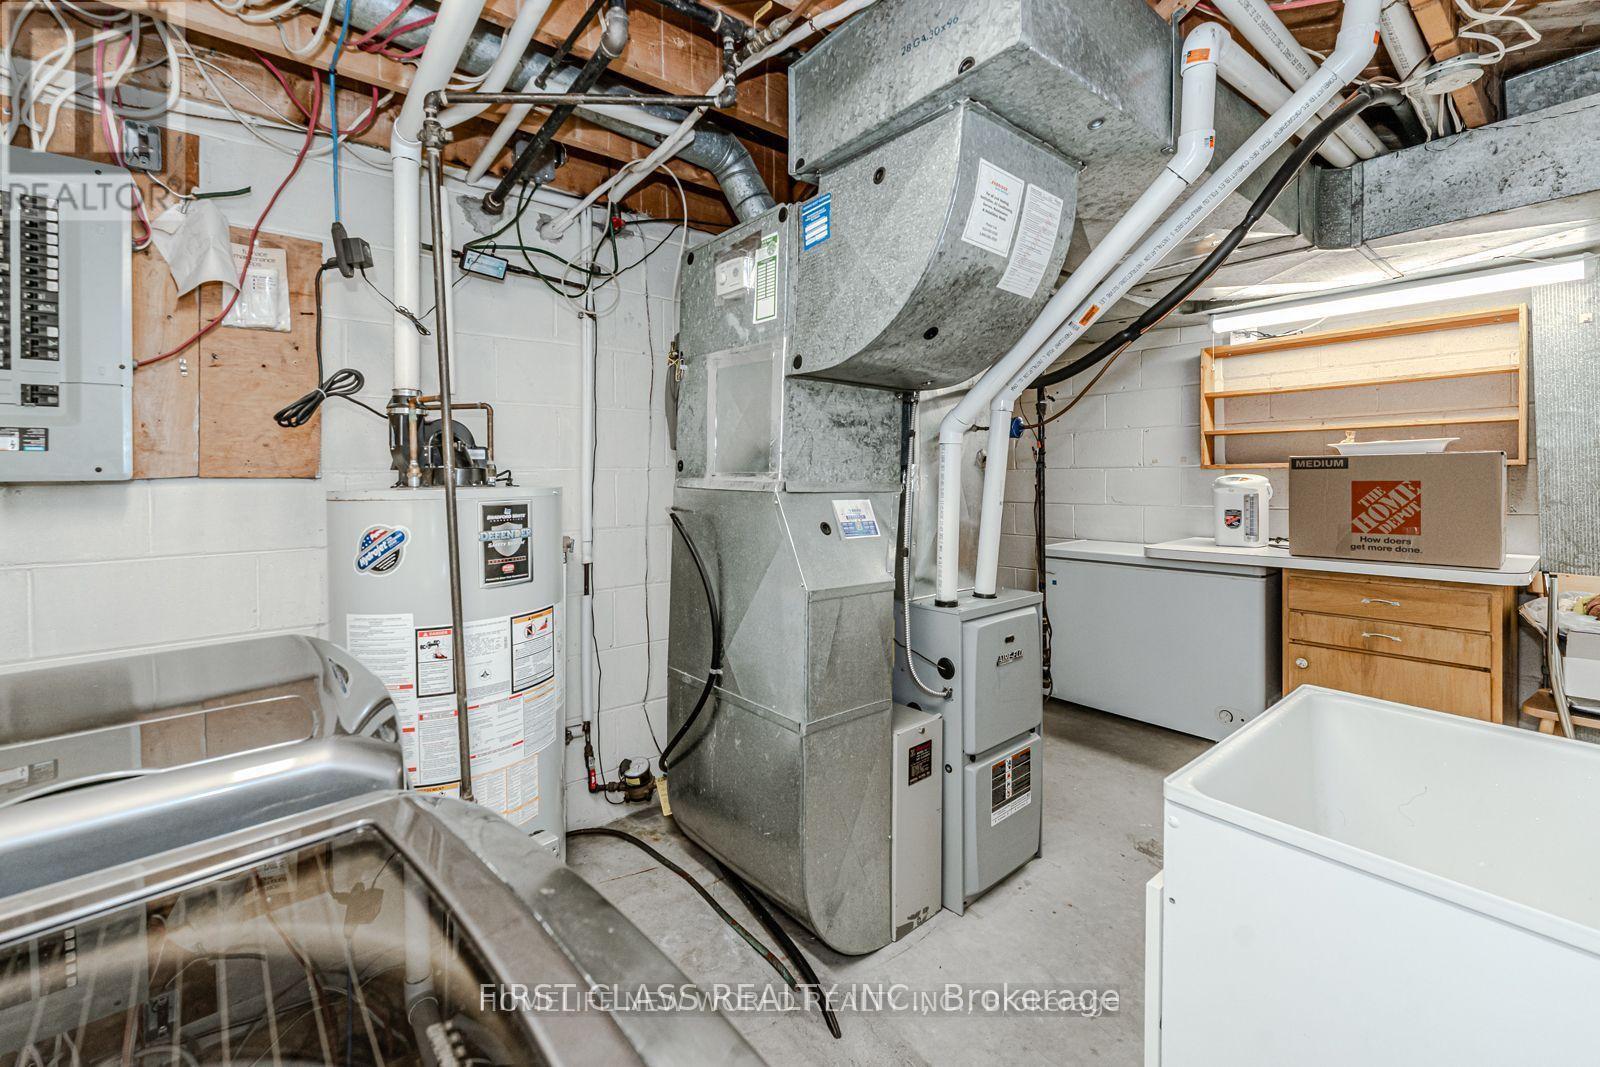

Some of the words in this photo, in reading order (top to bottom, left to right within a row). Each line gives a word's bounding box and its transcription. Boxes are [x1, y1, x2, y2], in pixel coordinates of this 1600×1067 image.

[1295, 459, 1344, 468] MEDIUM
[1357, 486, 1387, 508] THE
[1352, 480, 1421, 534] HOME
[1377, 500, 1421, 534] DEPOT
[479, 527, 532, 541] DEFENDER
[1360, 535, 1381, 544] How
[1384, 537, 1411, 545] doers
[1350, 543, 1366, 551] get
[1395, 543, 1423, 553] done.
